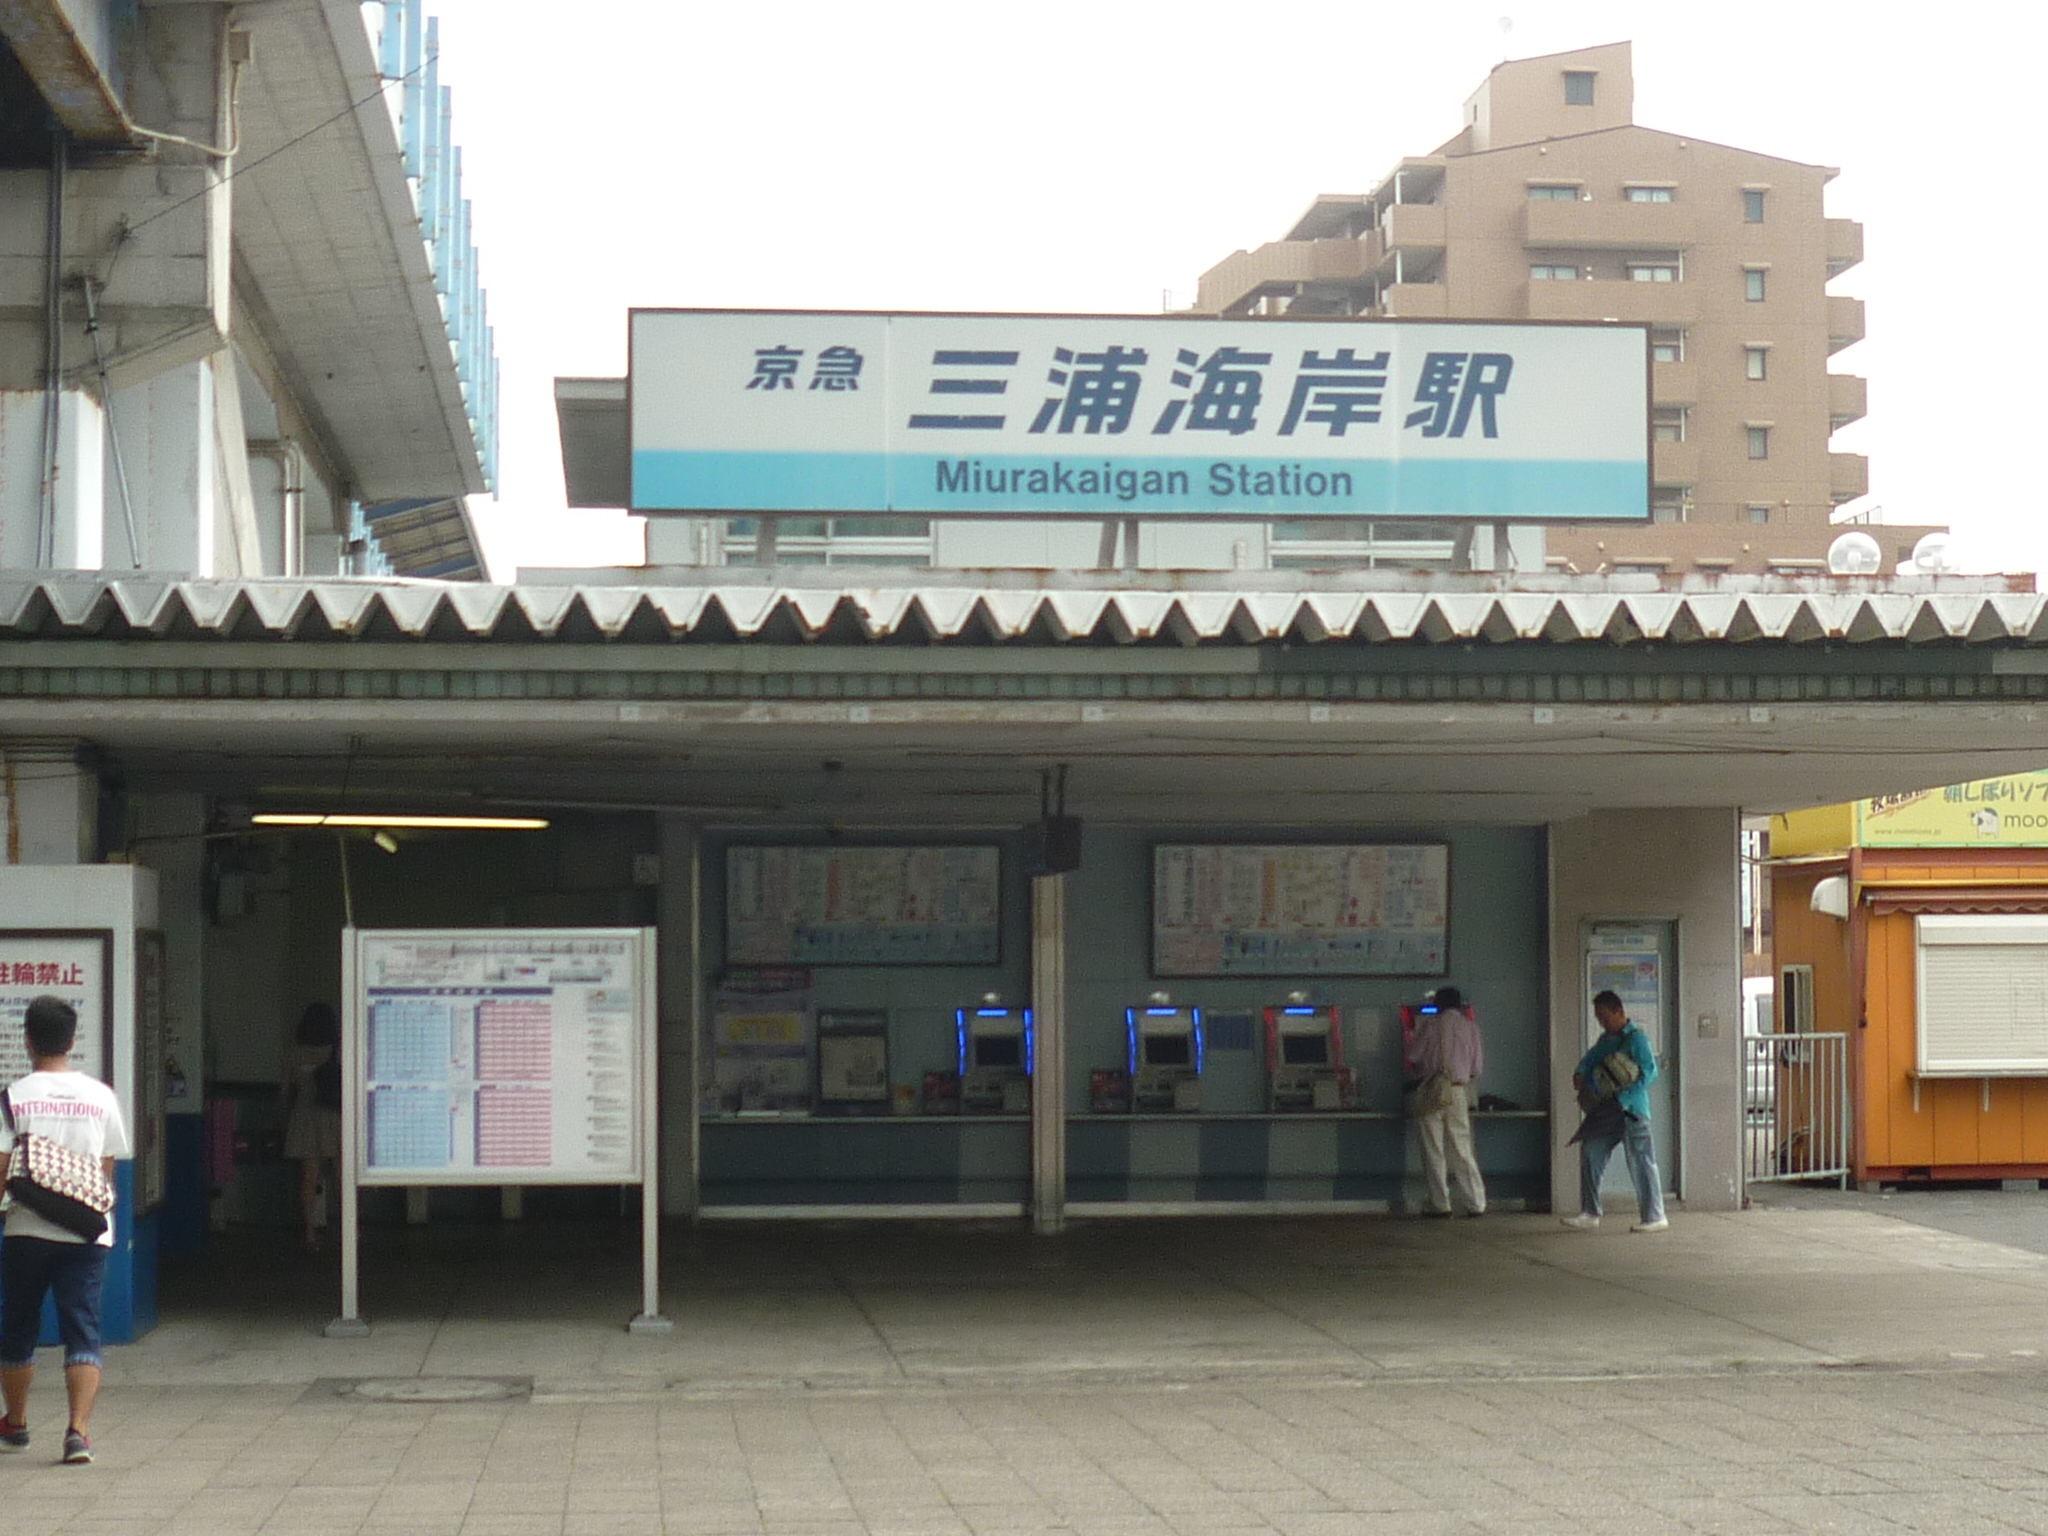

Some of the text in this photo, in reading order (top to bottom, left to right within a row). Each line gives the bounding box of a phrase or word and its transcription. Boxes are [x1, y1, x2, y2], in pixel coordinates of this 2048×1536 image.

[746, 345, 1513, 439] 京急 三浦海岸駅
[937, 460, 1351, 502] Miurakaigan Station
